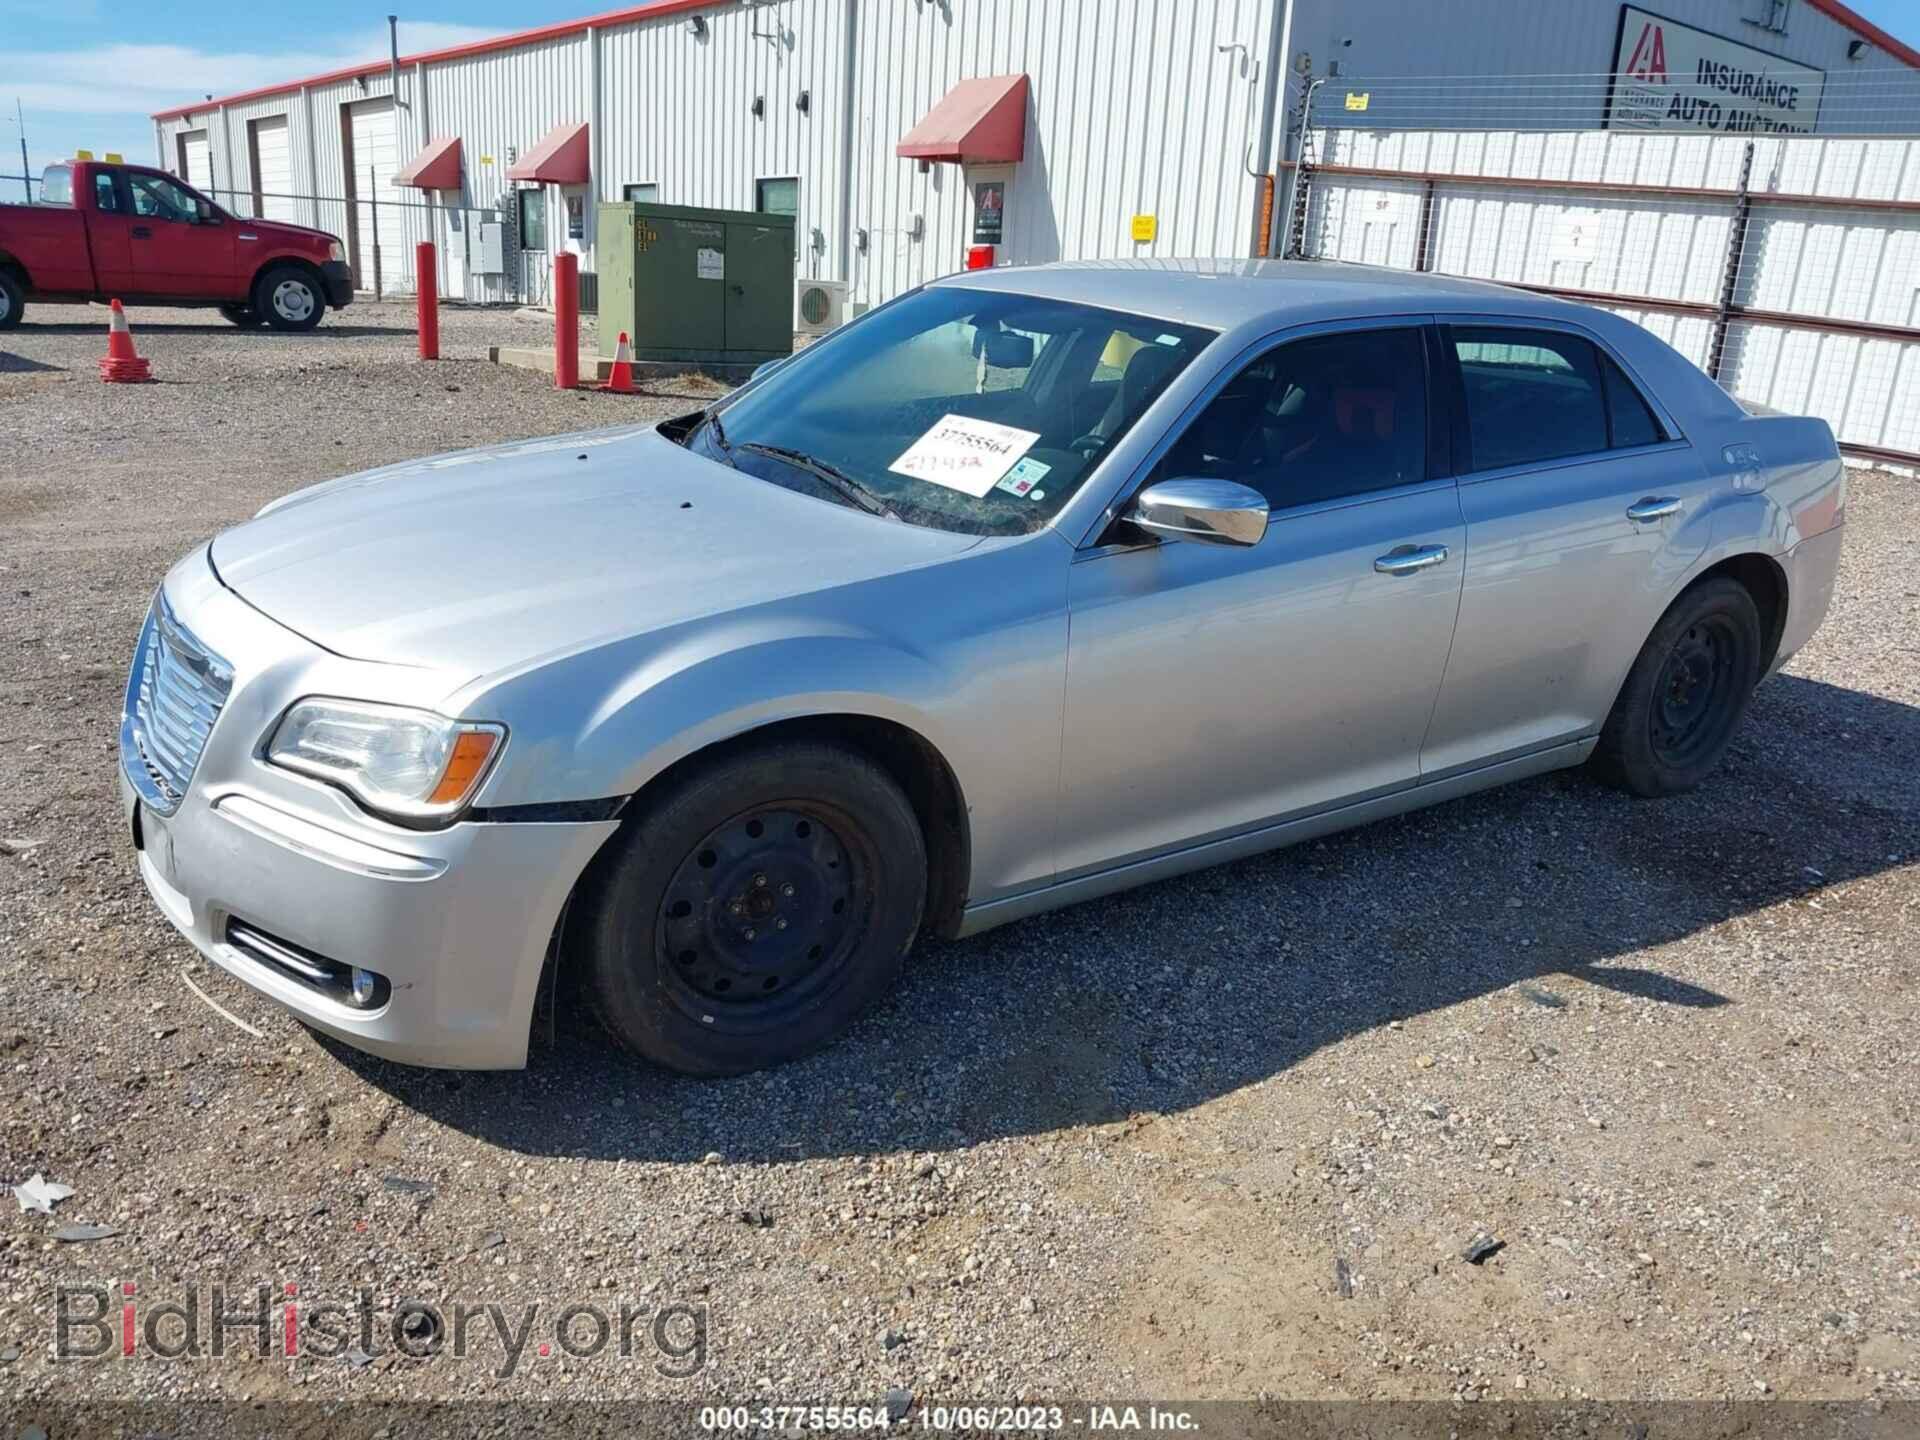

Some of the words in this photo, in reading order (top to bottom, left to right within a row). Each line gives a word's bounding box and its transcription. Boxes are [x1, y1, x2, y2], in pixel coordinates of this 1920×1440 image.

[1696, 58, 1800, 112] INSURANCE
[1667, 93, 1721, 130] AUTO
[1724, 108, 1809, 133] AUCTIO
[933, 428, 1012, 455] 37755564
